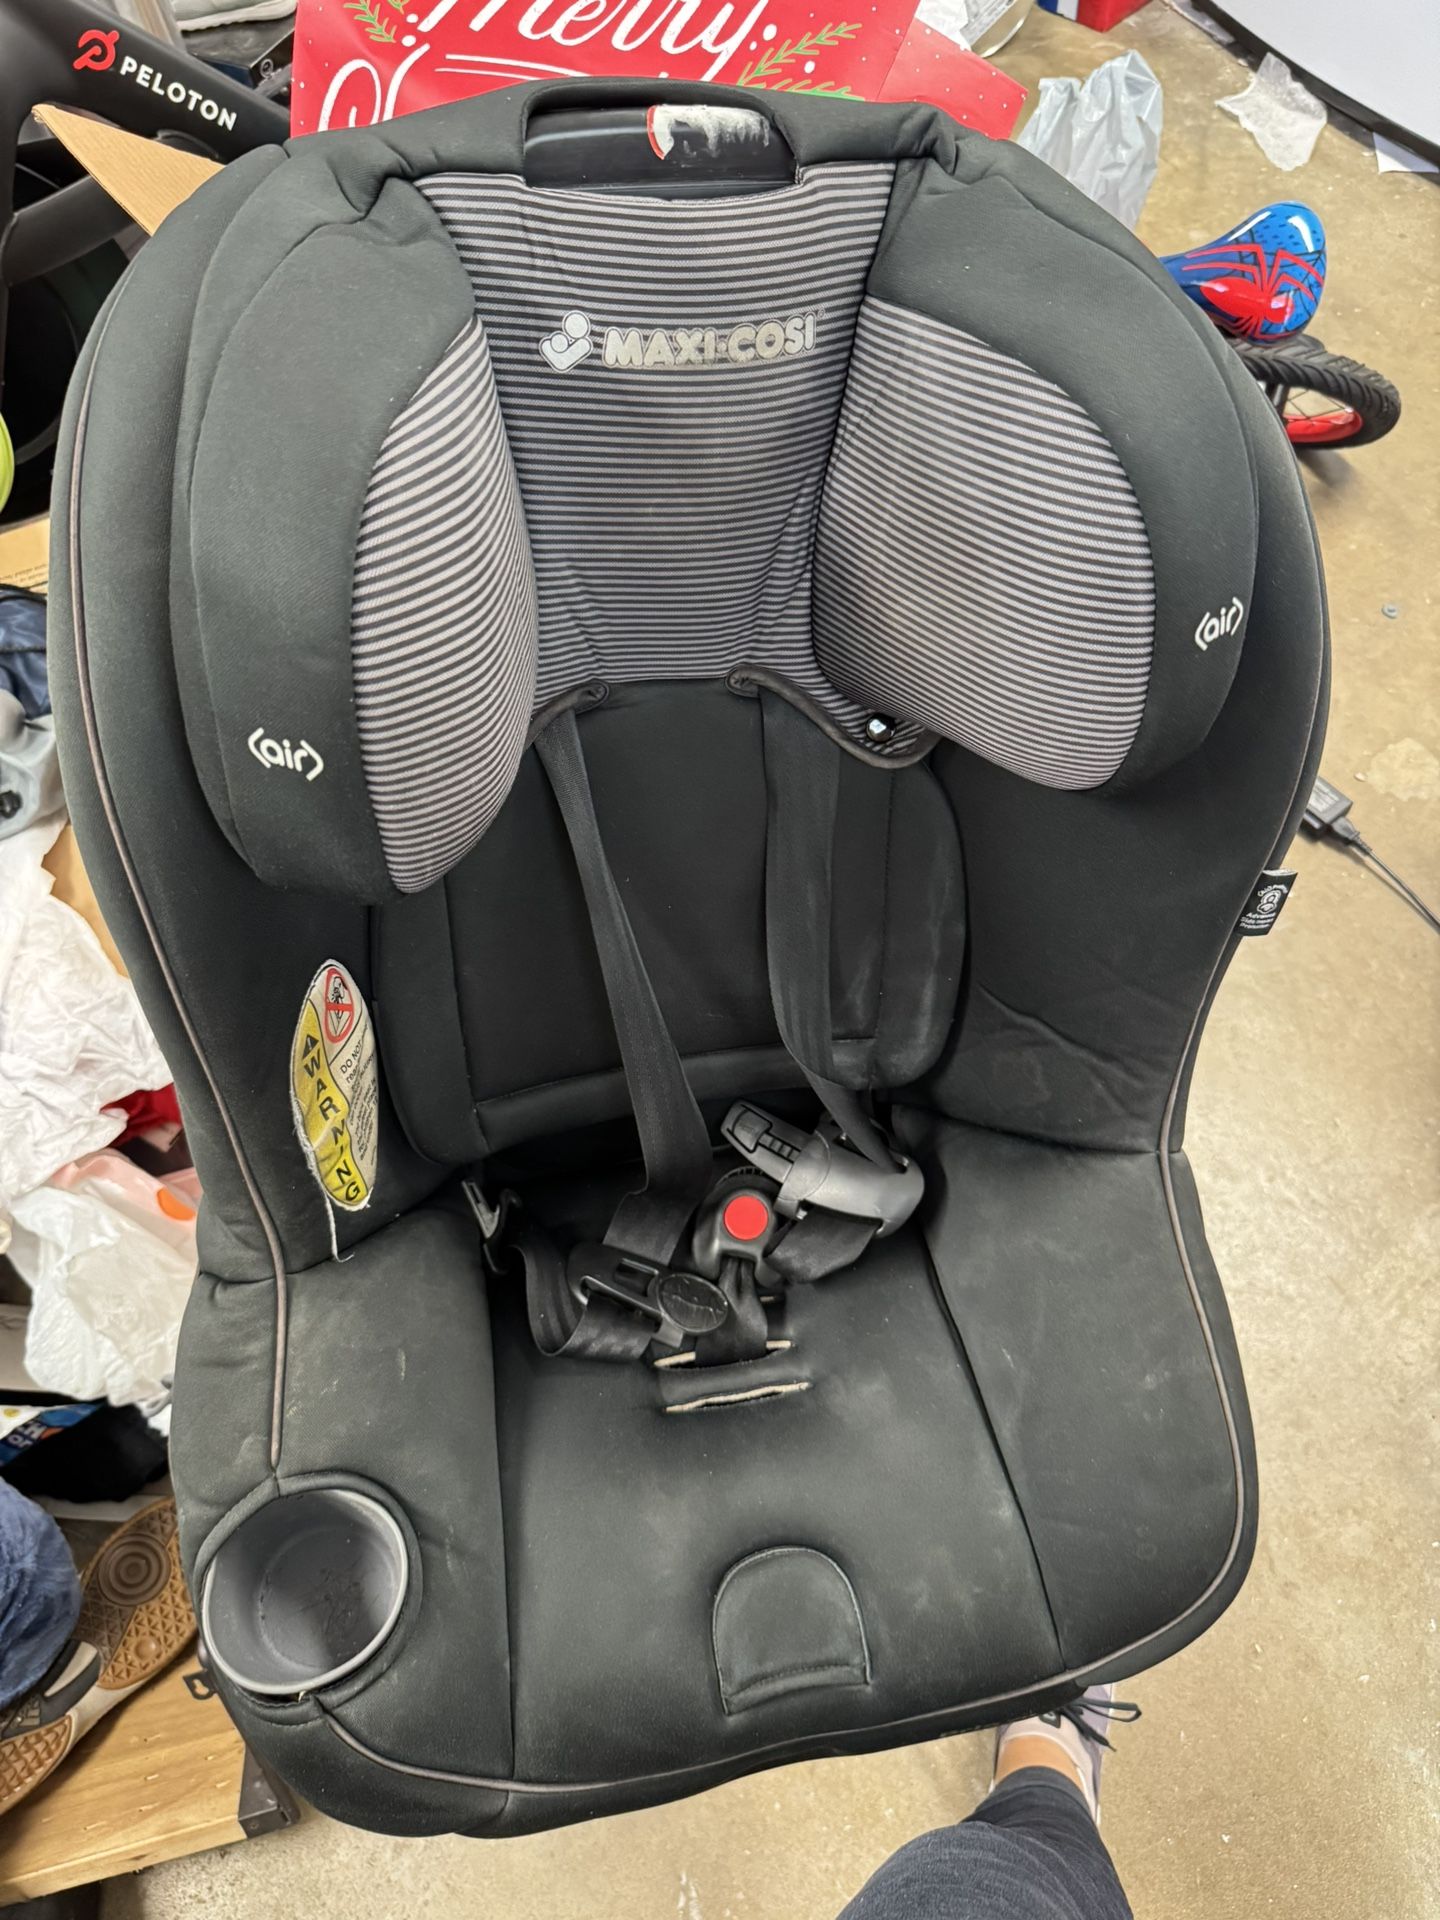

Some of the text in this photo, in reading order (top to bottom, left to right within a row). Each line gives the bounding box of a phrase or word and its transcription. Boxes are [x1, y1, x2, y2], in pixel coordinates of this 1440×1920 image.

[120, 56, 237, 131] PELOTON
[340, 1059, 353, 1075] DO
[303, 1049, 361, 1201] WARNING
